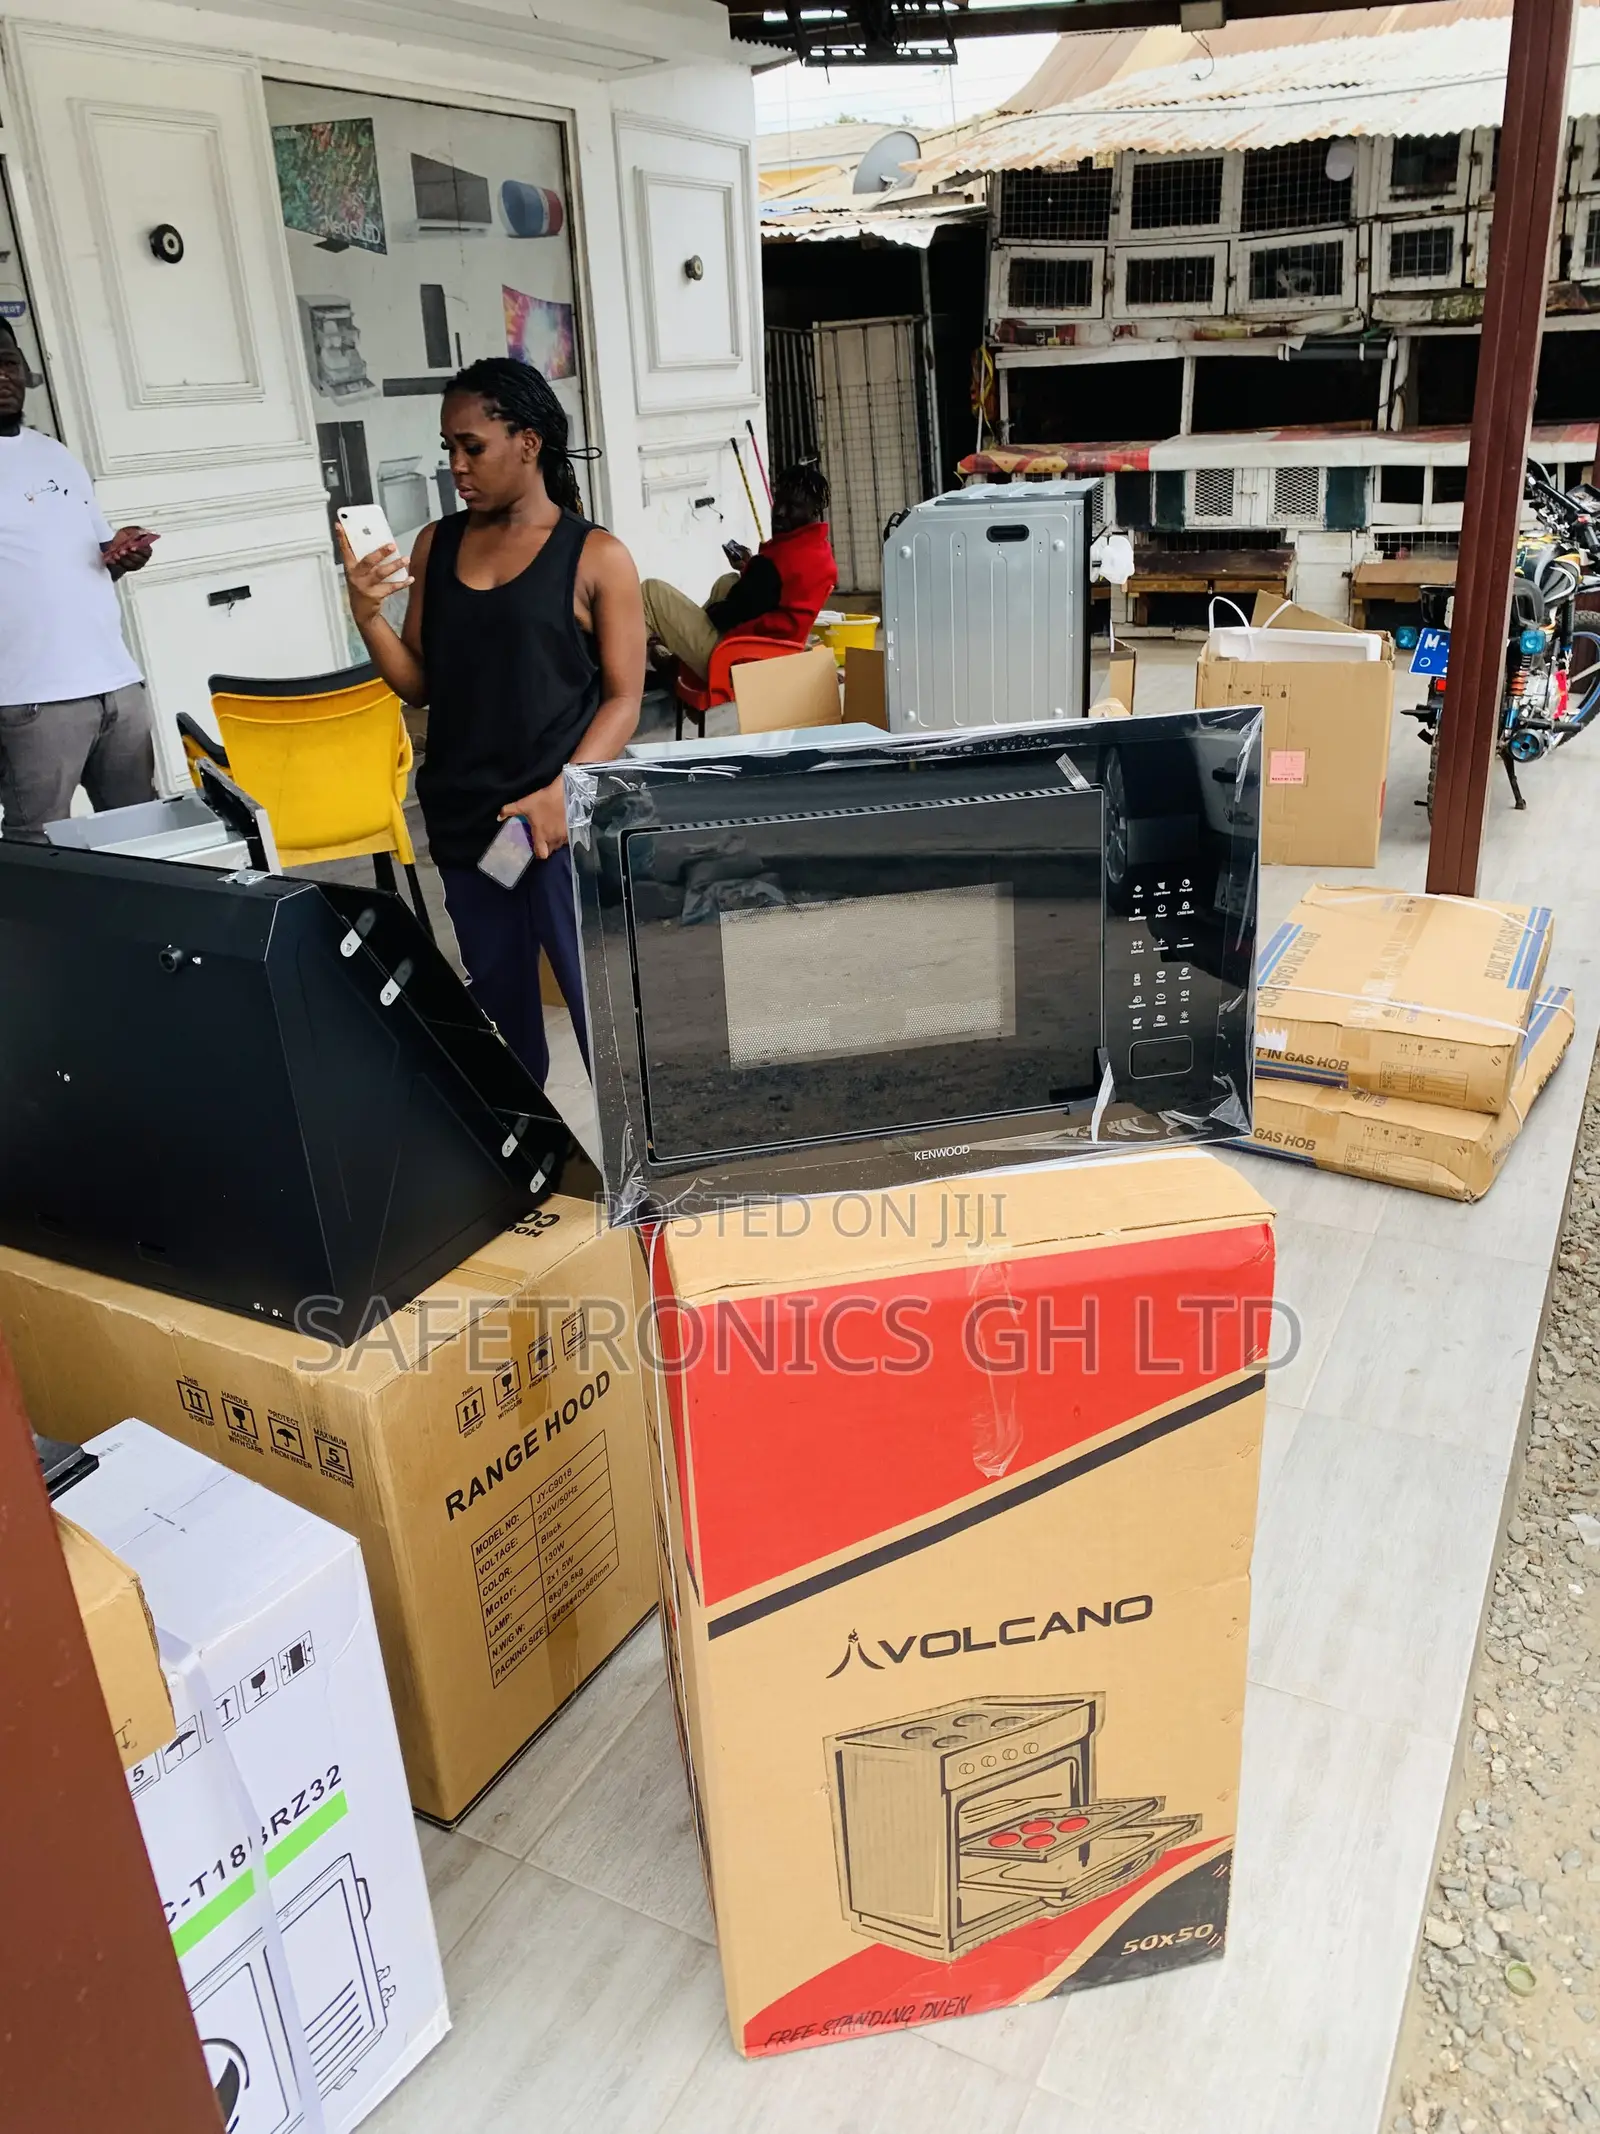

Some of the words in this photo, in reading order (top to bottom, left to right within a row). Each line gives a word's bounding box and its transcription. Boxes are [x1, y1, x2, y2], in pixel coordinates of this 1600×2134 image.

[1285, 1051, 1315, 1065] GAS
[1317, 1057, 1349, 1071] HOB
[1253, 1128, 1283, 1143] GAS
[1284, 1135, 1316, 1151] HOB
[914, 1145, 970, 1161] KENWOOD
[183, 1375, 199, 1386] THIS
[529, 1378, 542, 1389] FROM
[222, 1391, 249, 1407] HANDLE
[462, 1386, 473, 1397] THIS
[501, 1395, 519, 1410] HANDLE
[268, 1409, 299, 1427] PROTECT
[231, 1430, 257, 1445] HANDLE
[314, 1428, 347, 1447] MAXIMUM
[464, 1427, 475, 1438] SIDE
[476, 1421, 483, 1429] UP
[229, 1435, 246, 1448] WITH
[246, 1443, 264, 1455] CARE
[445, 1428, 540, 1521] RANGE
[544, 1370, 610, 1442] HOOD
[271, 1447, 290, 1460] FROM
[290, 1454, 312, 1469] WATER
[320, 1469, 355, 1488] STACKING
[475, 1529, 504, 1556] MODEL
[505, 1514, 520, 1532] NO:
[536, 1468, 572, 1504] JY-C9018
[479, 1538, 519, 1576] VOLTAGE:
[537, 1485, 578, 1525] 220V/50Hz
[482, 1567, 513, 1597] COLOR:
[541, 1522, 562, 1545] Black
[486, 1585, 517, 1618] Motor:
[544, 1541, 565, 1564] 130W
[489, 1613, 513, 1638] LAMP:
[546, 1555, 574, 1586] 2x1.5W
[877, 1594, 1152, 1664] VOLCANO
[495, 1644, 528, 1679] PACKING
[528, 1626, 547, 1650] SIZE:
[1120, 1923, 1214, 1956] 50x50
[764, 2022, 818, 2049] FREE
[819, 2005, 916, 2038] STANDING
